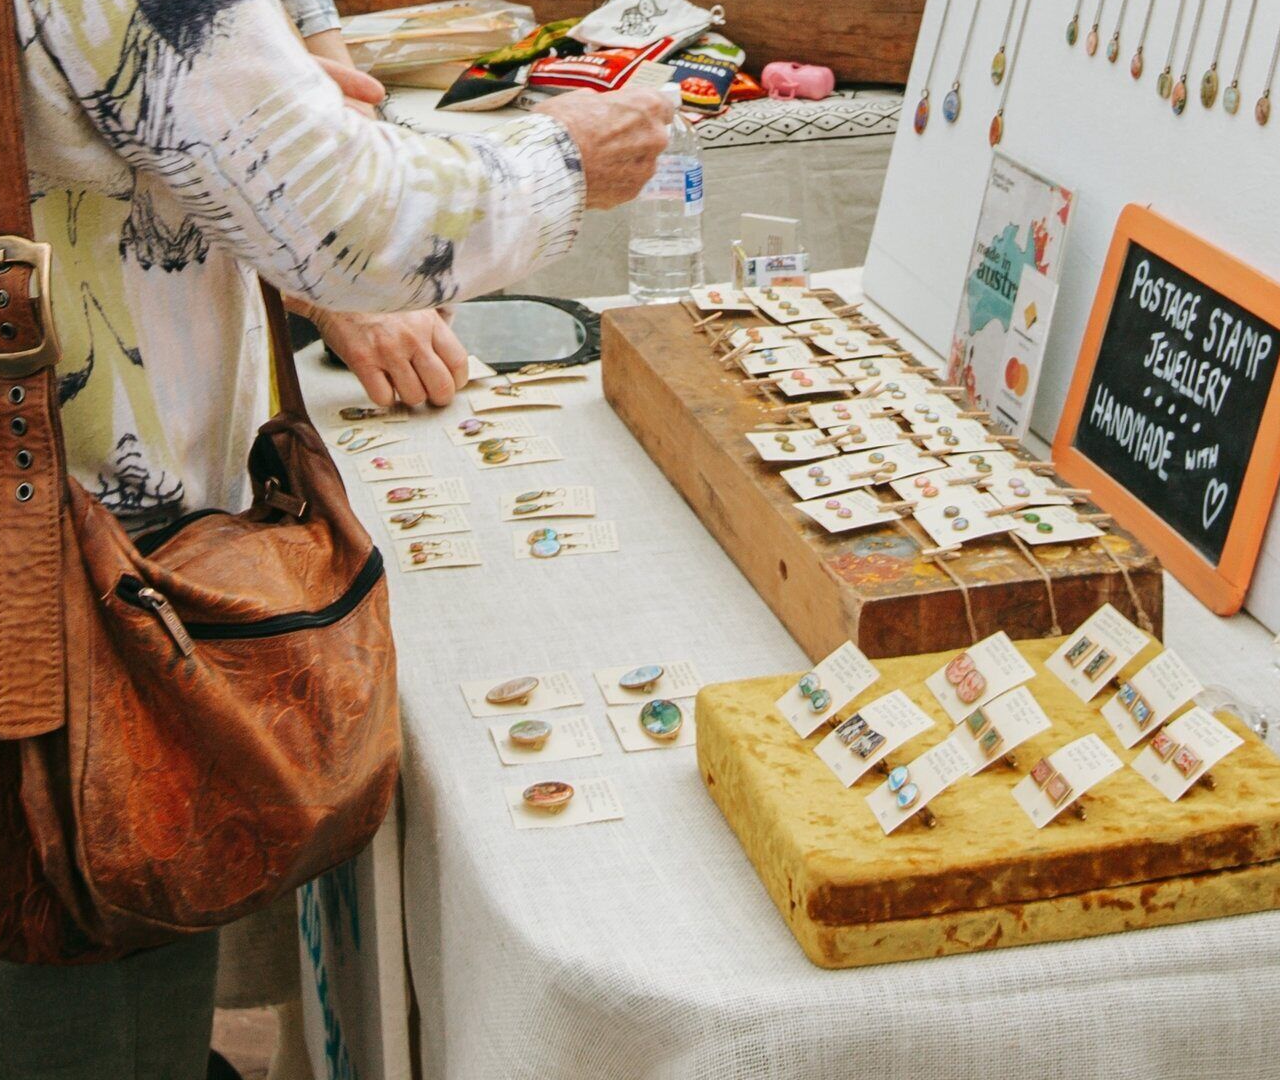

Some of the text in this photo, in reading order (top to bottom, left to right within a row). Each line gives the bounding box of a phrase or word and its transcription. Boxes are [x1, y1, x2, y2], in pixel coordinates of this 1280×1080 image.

[976, 242, 1012, 271] made in
[1129, 259, 1273, 382] POSTAGE STAMP
[1143, 331, 1232, 417] JEWELLERY
[1089, 382, 1219, 482] HANDMADE WITH
